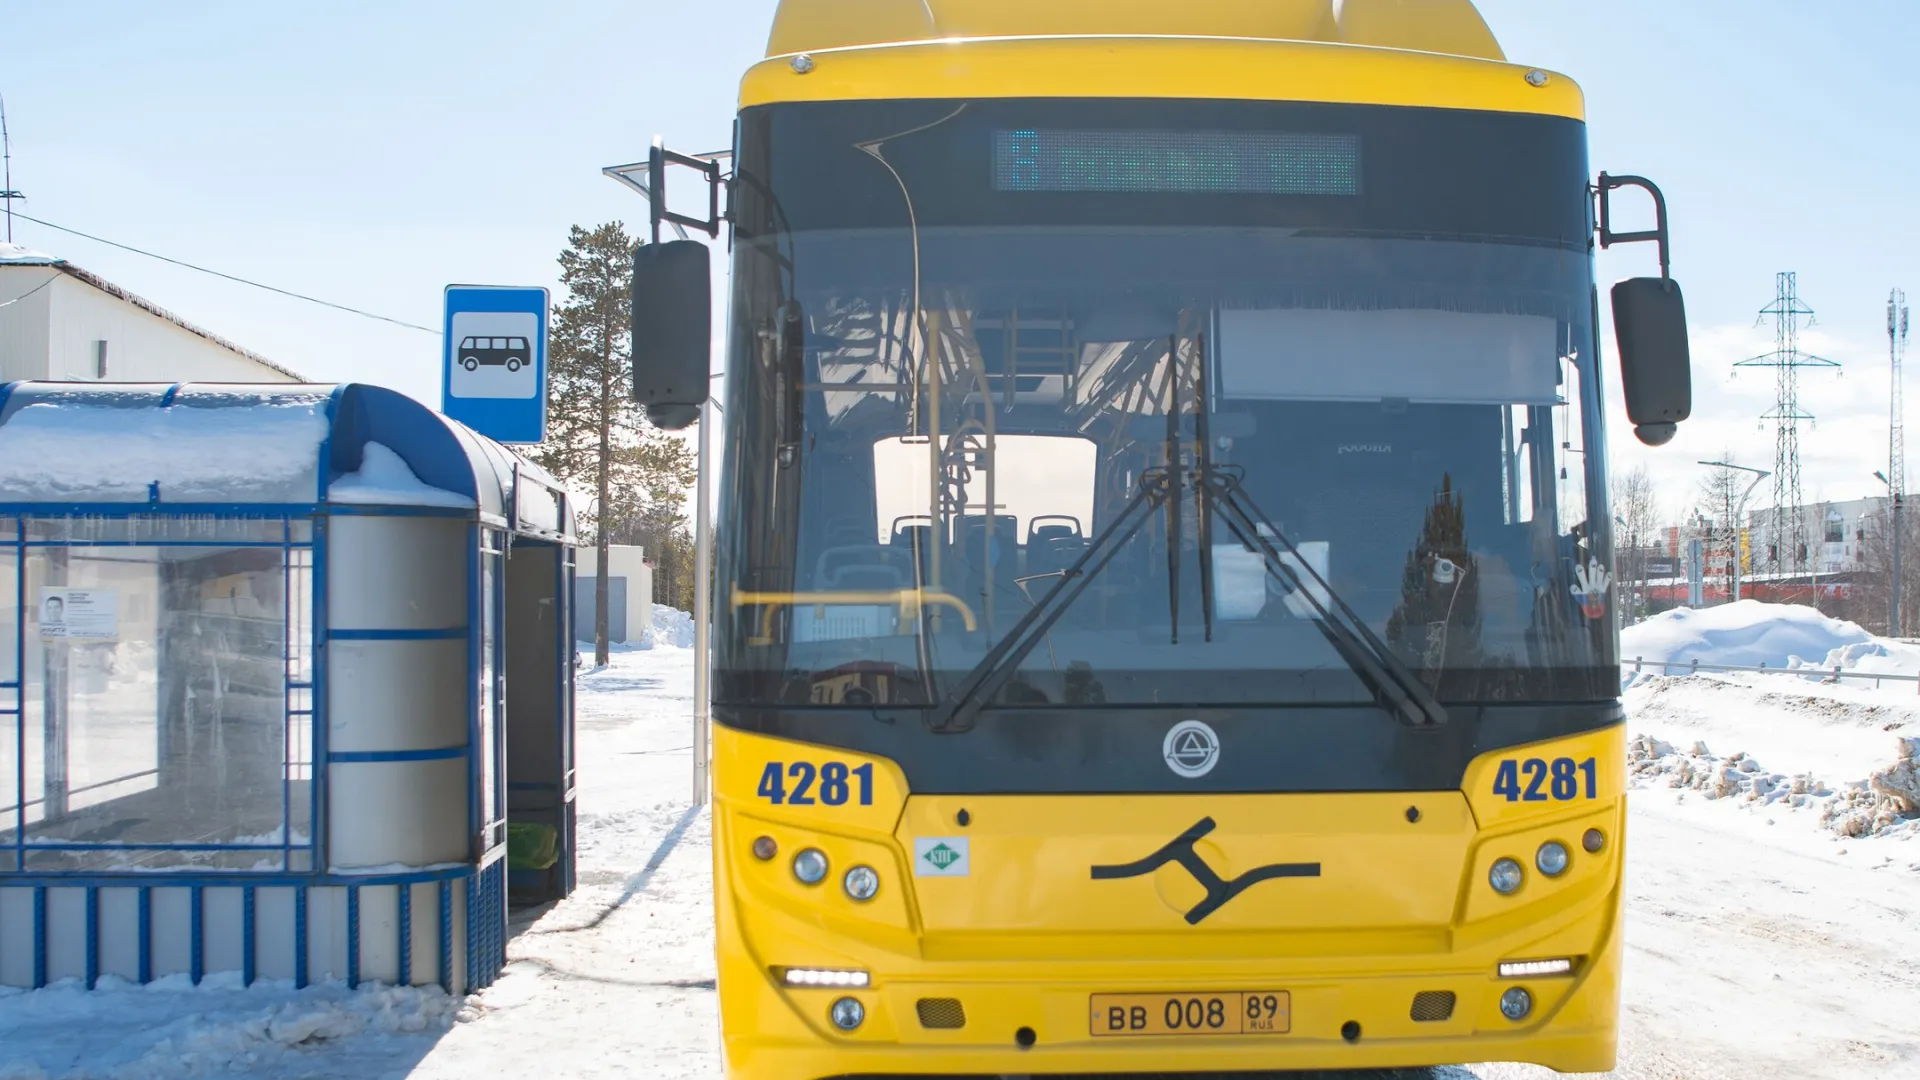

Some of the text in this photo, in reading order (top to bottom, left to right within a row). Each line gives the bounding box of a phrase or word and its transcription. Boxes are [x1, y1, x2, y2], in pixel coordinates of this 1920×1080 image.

[757, 761, 873, 806] 4281
[1492, 756, 1597, 802] 4281
[1164, 997, 1225, 1029] 008
[1246, 995, 1278, 1019] 89
[1250, 1020, 1274, 1030] RUS
